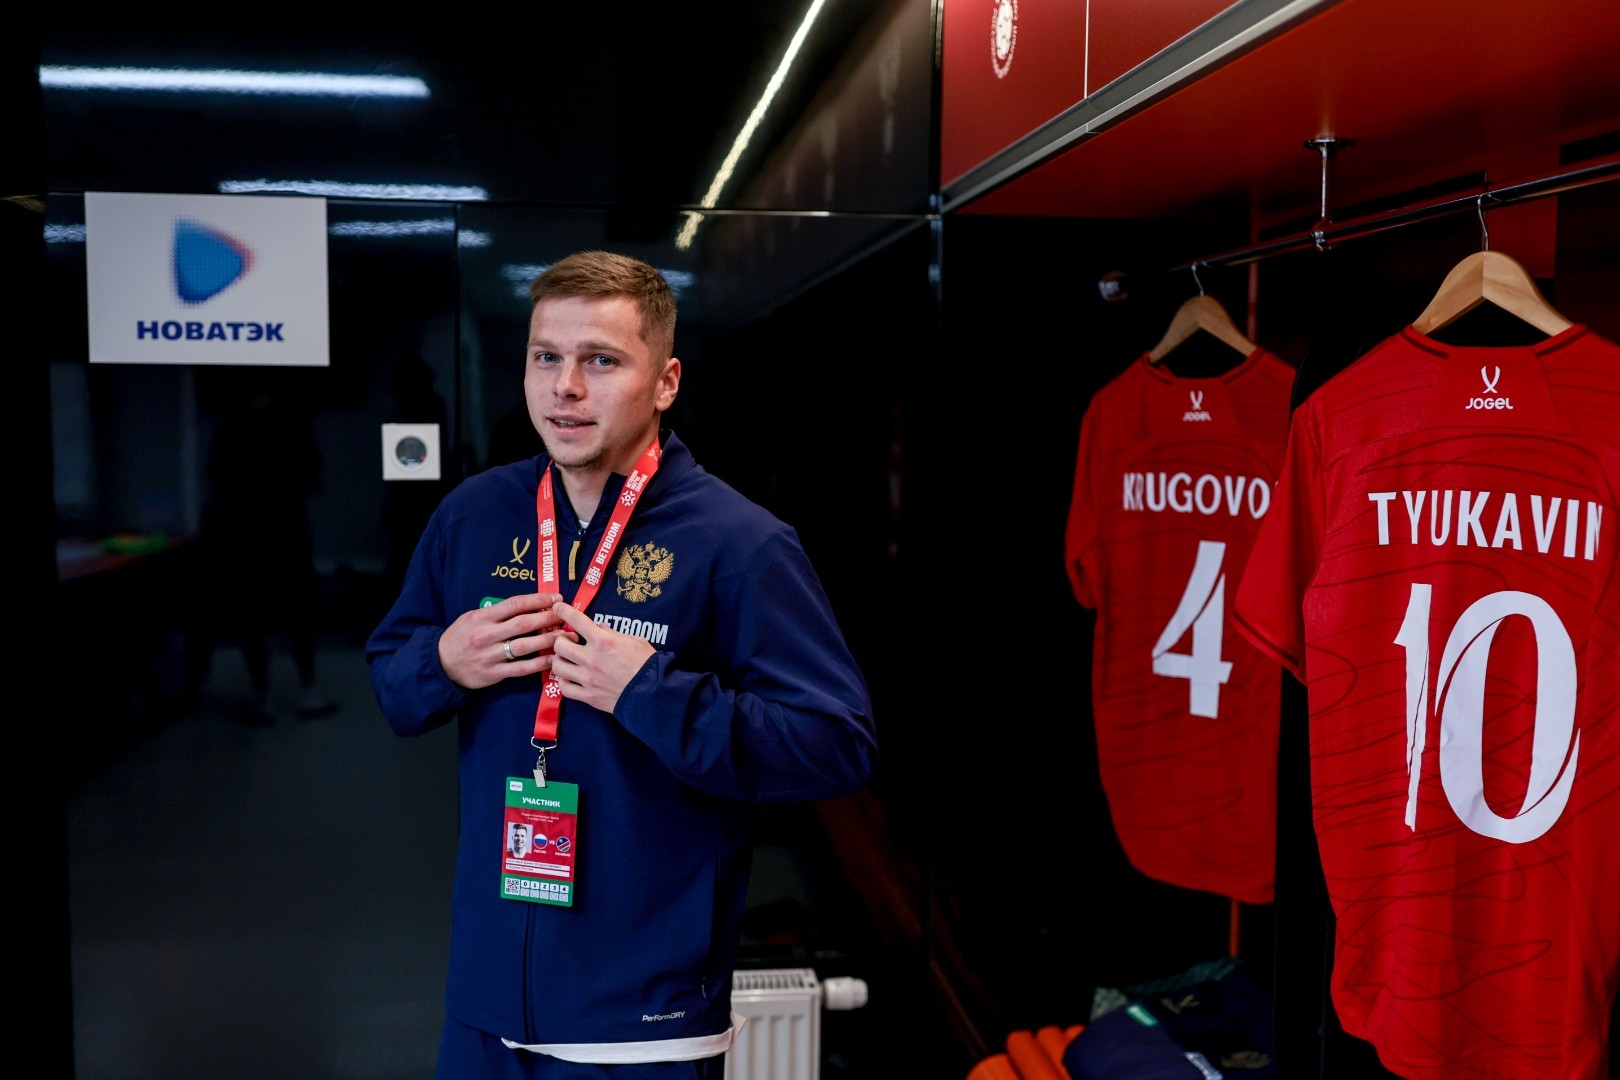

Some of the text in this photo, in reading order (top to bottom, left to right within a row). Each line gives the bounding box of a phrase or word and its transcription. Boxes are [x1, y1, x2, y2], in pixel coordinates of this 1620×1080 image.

[137, 320, 285, 343] НОВАТЭК
[1123, 472, 1278, 520] KRUGOVO
[595, 521, 621, 565] BETBOOM
[1368, 490, 1603, 560] TYUKAVIN
[543, 539, 554, 582] BETBOOM
[1152, 540, 1233, 719] 4
[1393, 583, 1581, 844] 10
[522, 796, 561, 808] УЧАСТНИК
